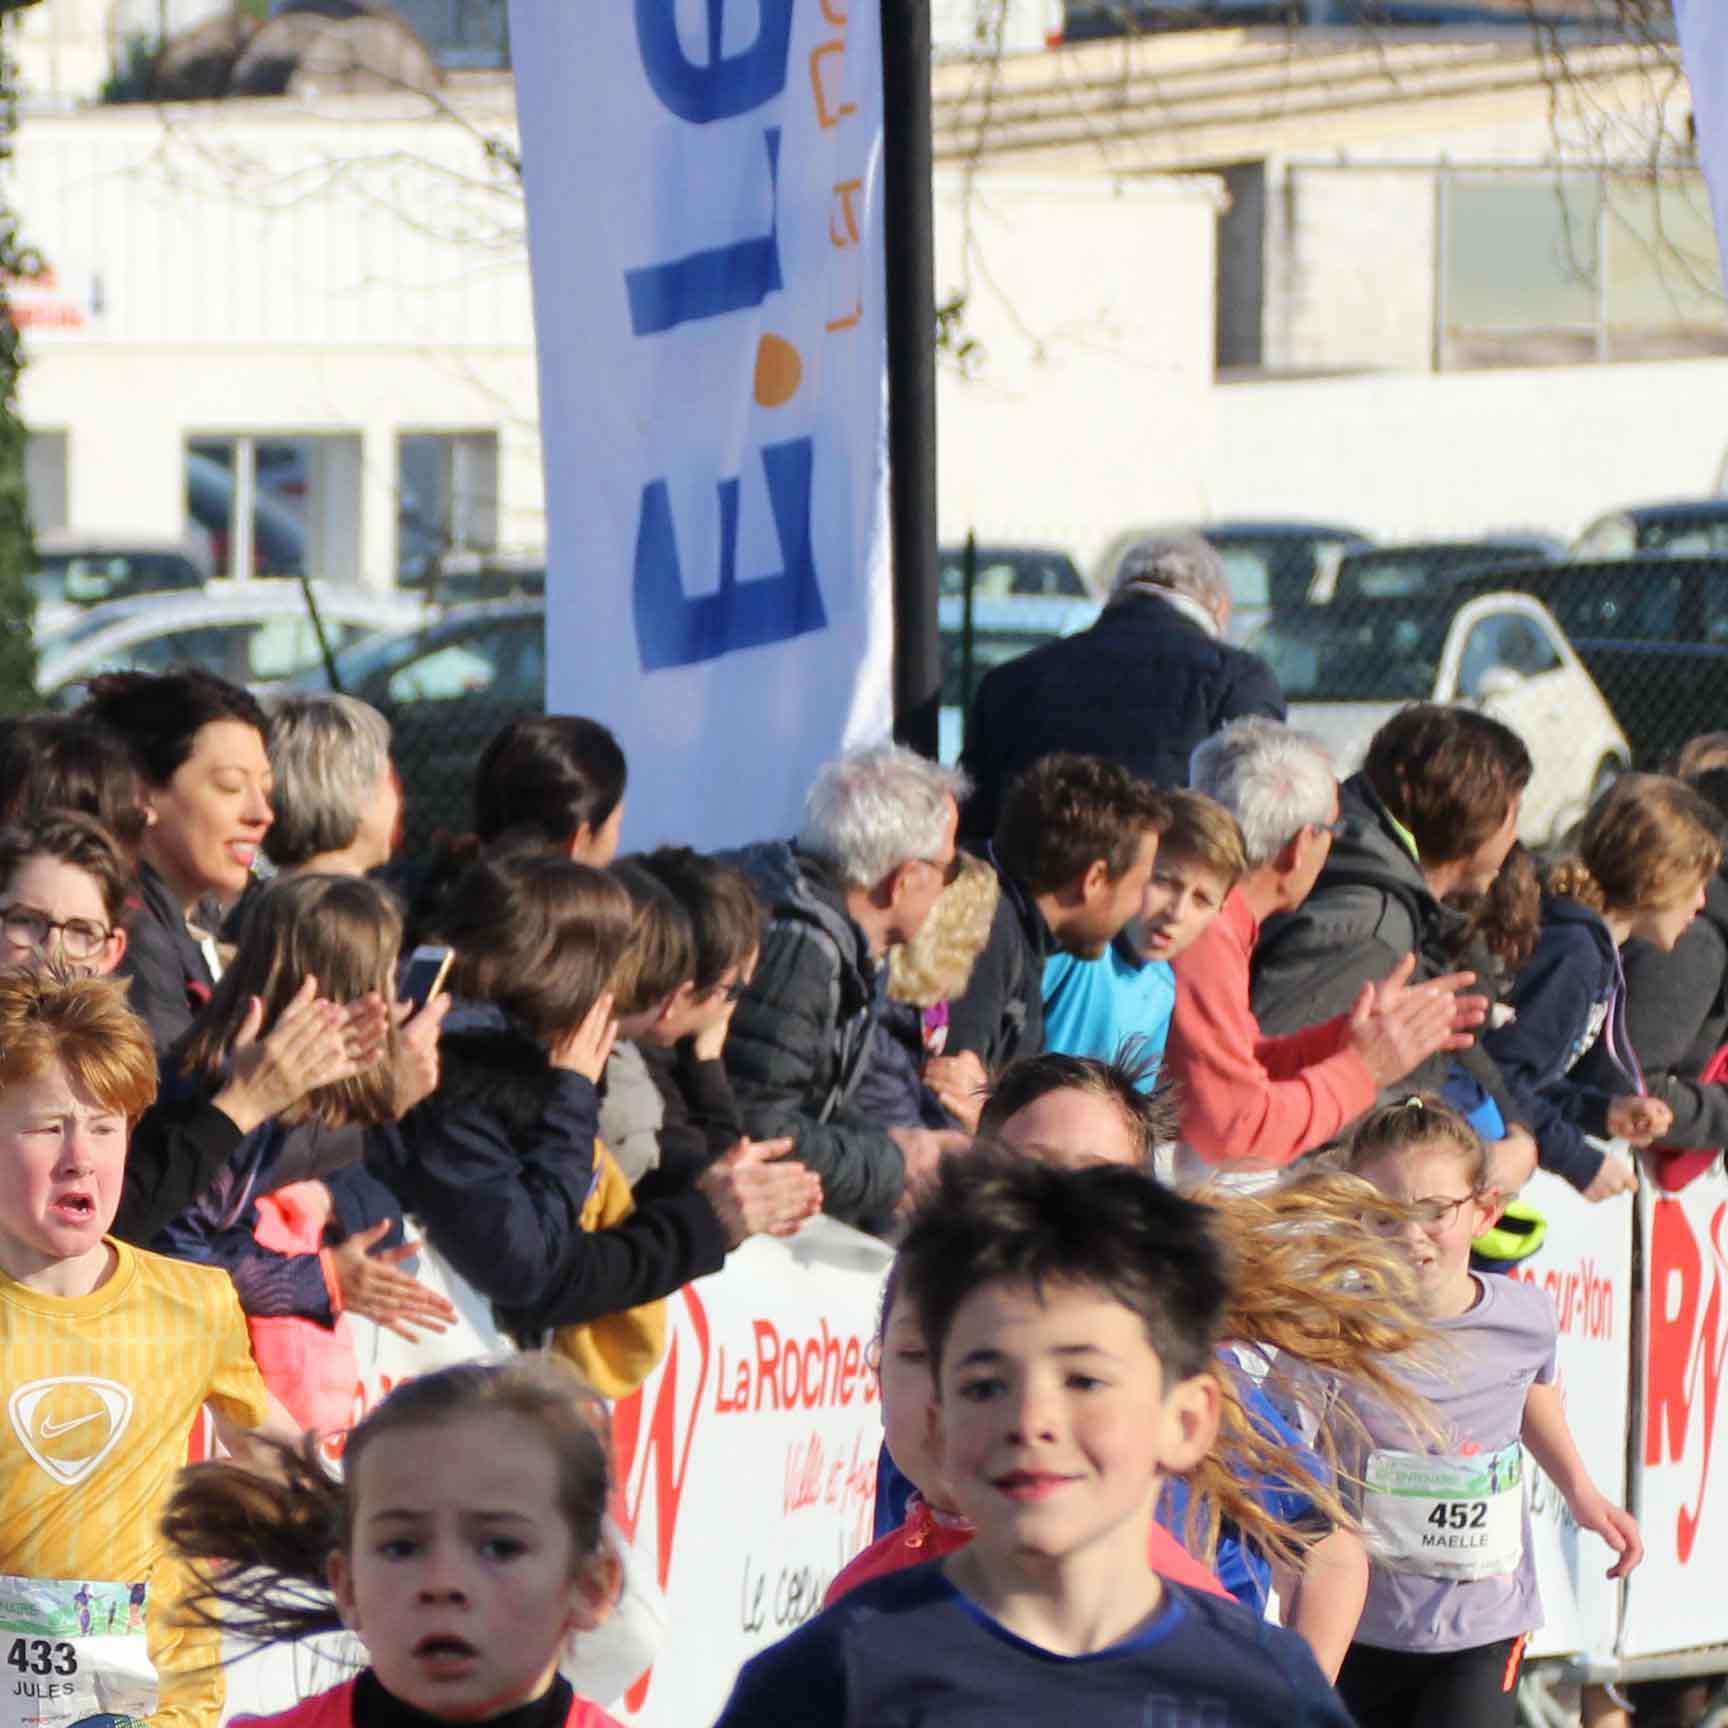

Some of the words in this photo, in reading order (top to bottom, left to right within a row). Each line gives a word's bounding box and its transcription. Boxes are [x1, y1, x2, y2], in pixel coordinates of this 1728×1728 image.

[1427, 1501, 1488, 1530] 452
[1421, 1532, 1489, 1549] MAELLE
[7, 1638, 78, 1677] 433
[13, 1681, 75, 1700] JULES
